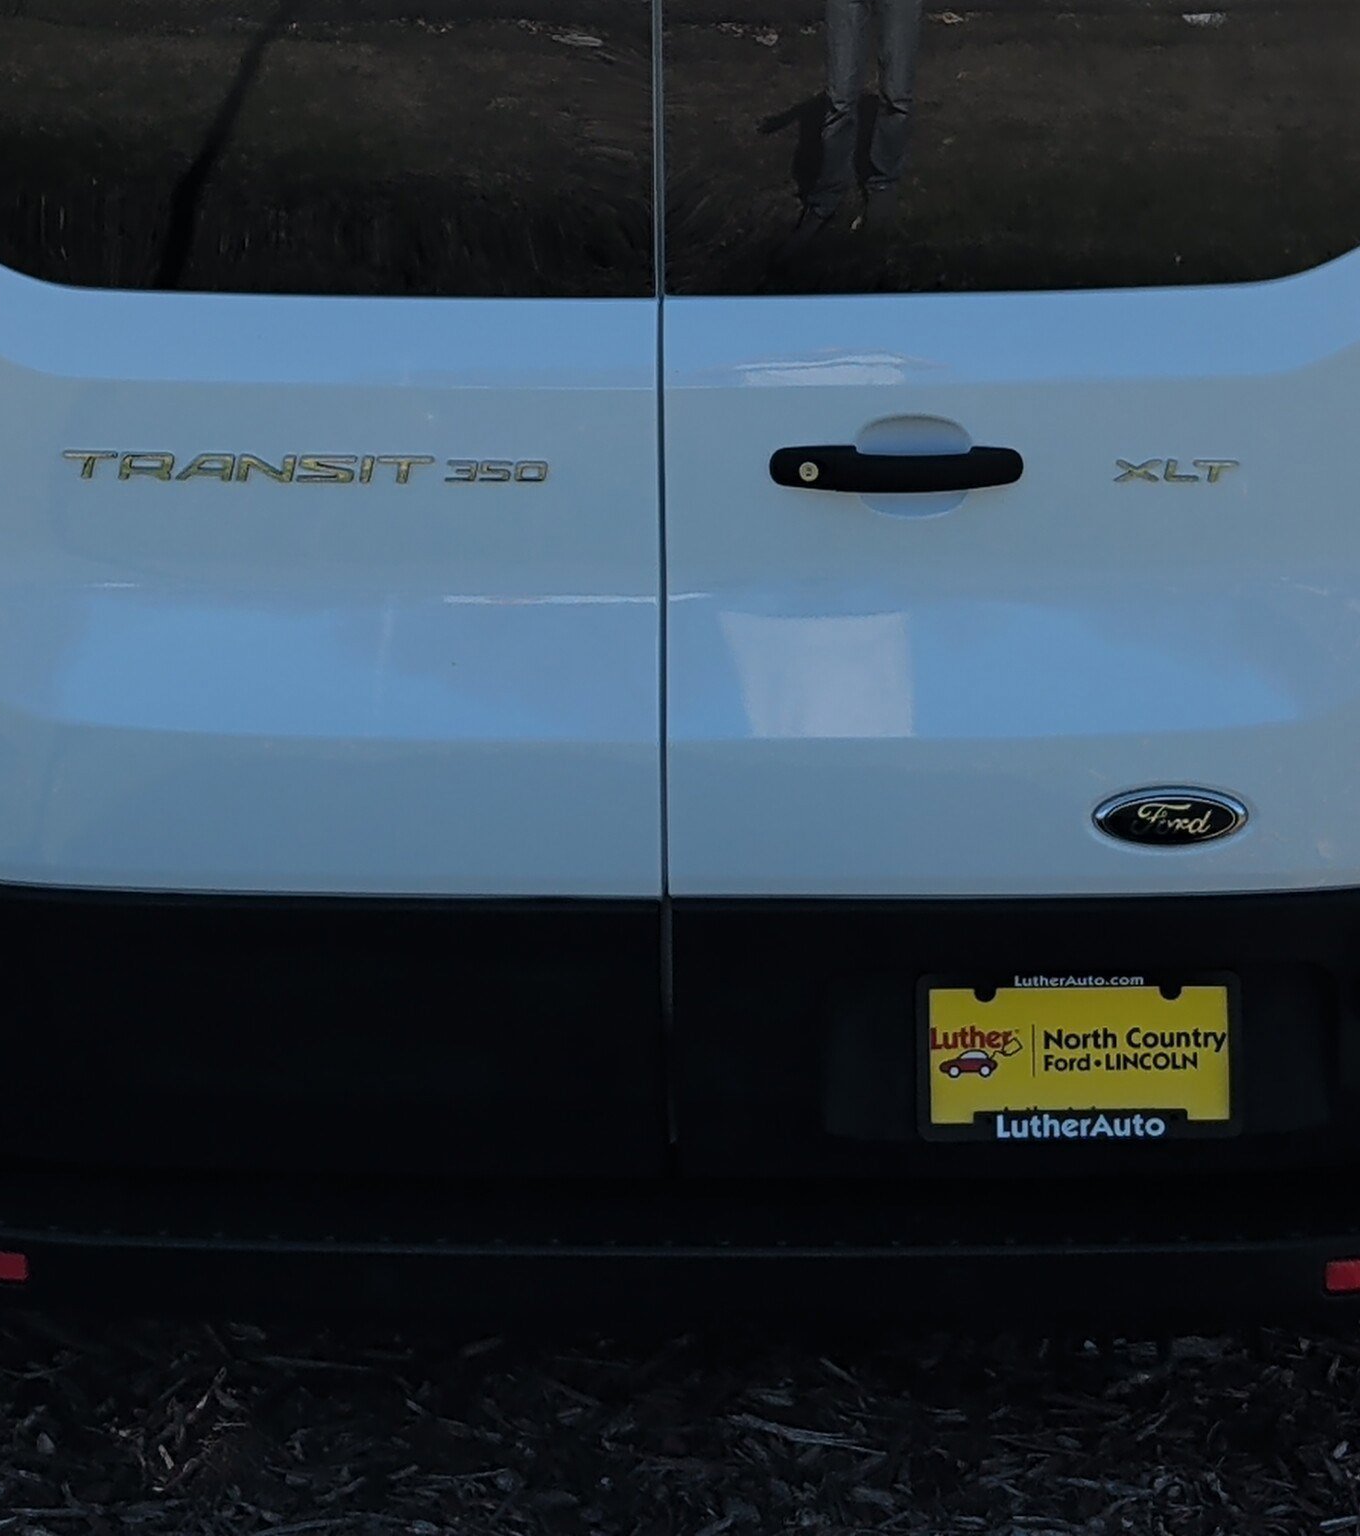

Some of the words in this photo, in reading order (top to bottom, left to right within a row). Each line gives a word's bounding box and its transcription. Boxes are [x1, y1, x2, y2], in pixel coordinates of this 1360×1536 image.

[62, 449, 436, 484] TRANSIT
[444, 459, 549, 483] 350
[1113, 458, 1240, 483] XLT
[1131, 802, 1213, 835] Ford
[1013, 975, 1145, 988] LutherAuto.com
[929, 1025, 1013, 1050] Luther
[1043, 1027, 1118, 1050] North
[1125, 1026, 1227, 1053] Country
[996, 1113, 1167, 1139] LutherAuto
